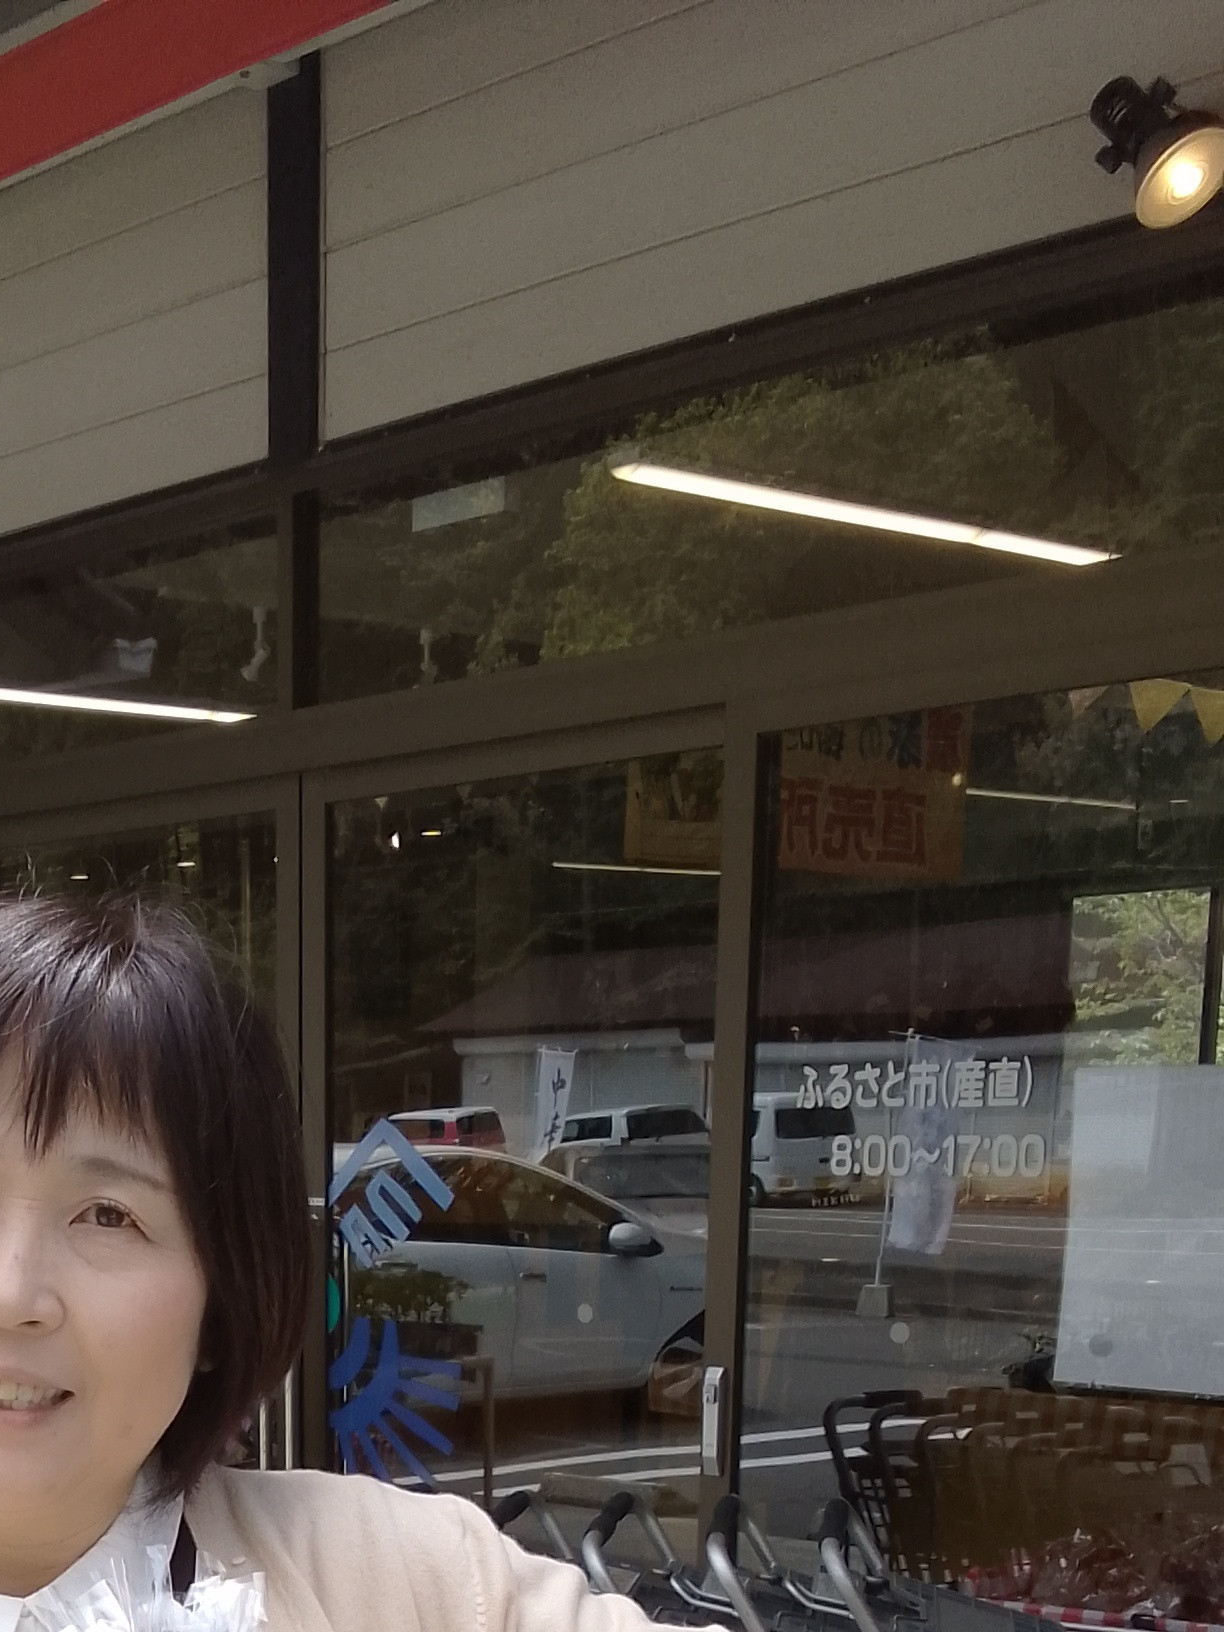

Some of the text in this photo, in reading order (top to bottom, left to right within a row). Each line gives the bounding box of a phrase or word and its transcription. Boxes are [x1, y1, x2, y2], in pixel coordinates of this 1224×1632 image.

[795, 1054, 1034, 1110] ふるさと市(産直)
